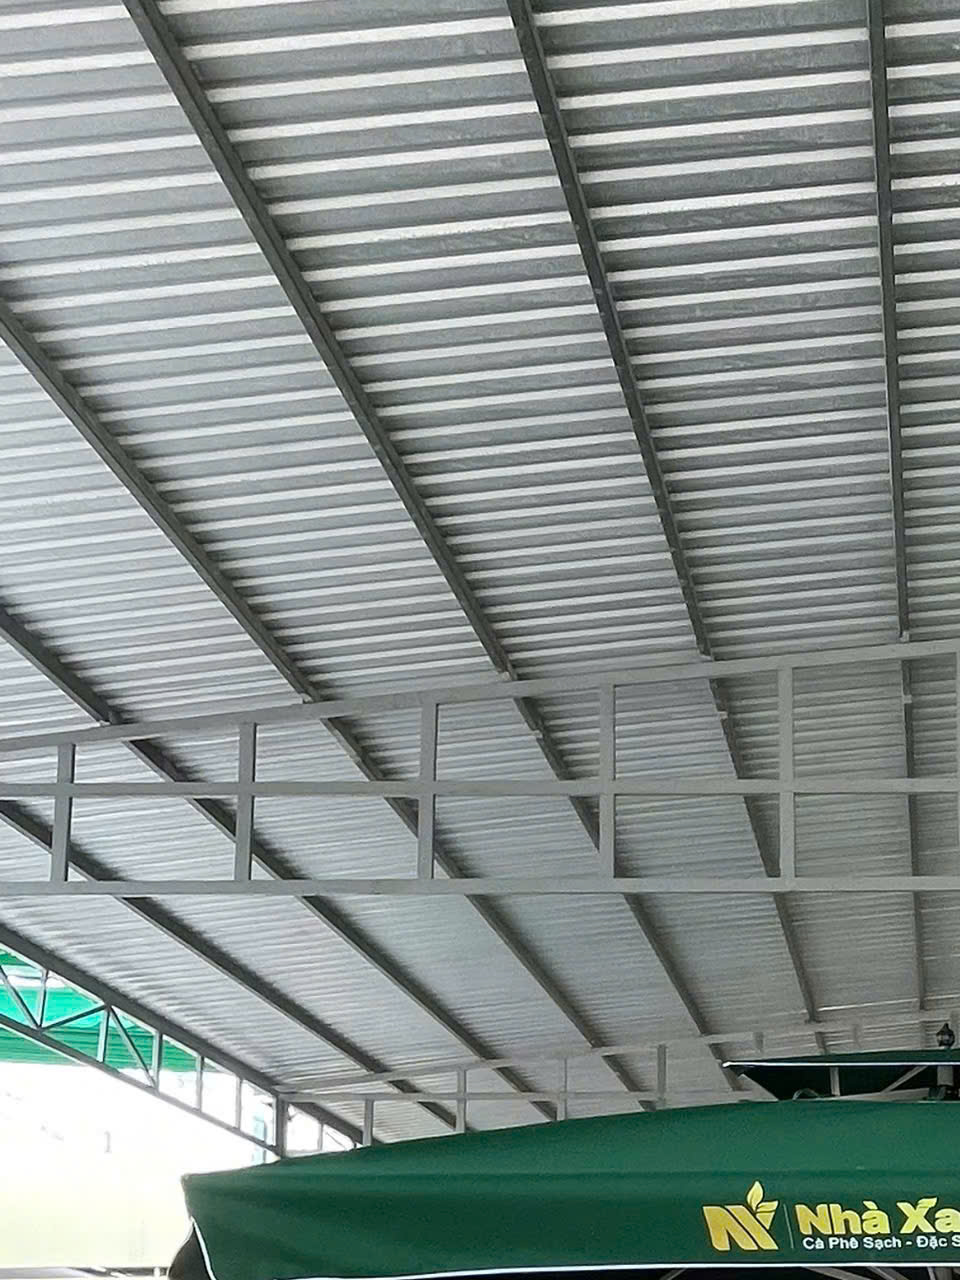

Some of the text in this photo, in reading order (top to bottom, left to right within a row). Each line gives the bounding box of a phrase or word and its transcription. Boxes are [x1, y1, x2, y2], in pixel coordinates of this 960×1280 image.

[795, 1200, 891, 1235] Nhà
[802, 1237, 825, 1250] Cà
[828, 1237, 858, 1249] Phê
[863, 1236, 902, 1250] Sạch
[916, 1235, 948, 1250] Đặc
